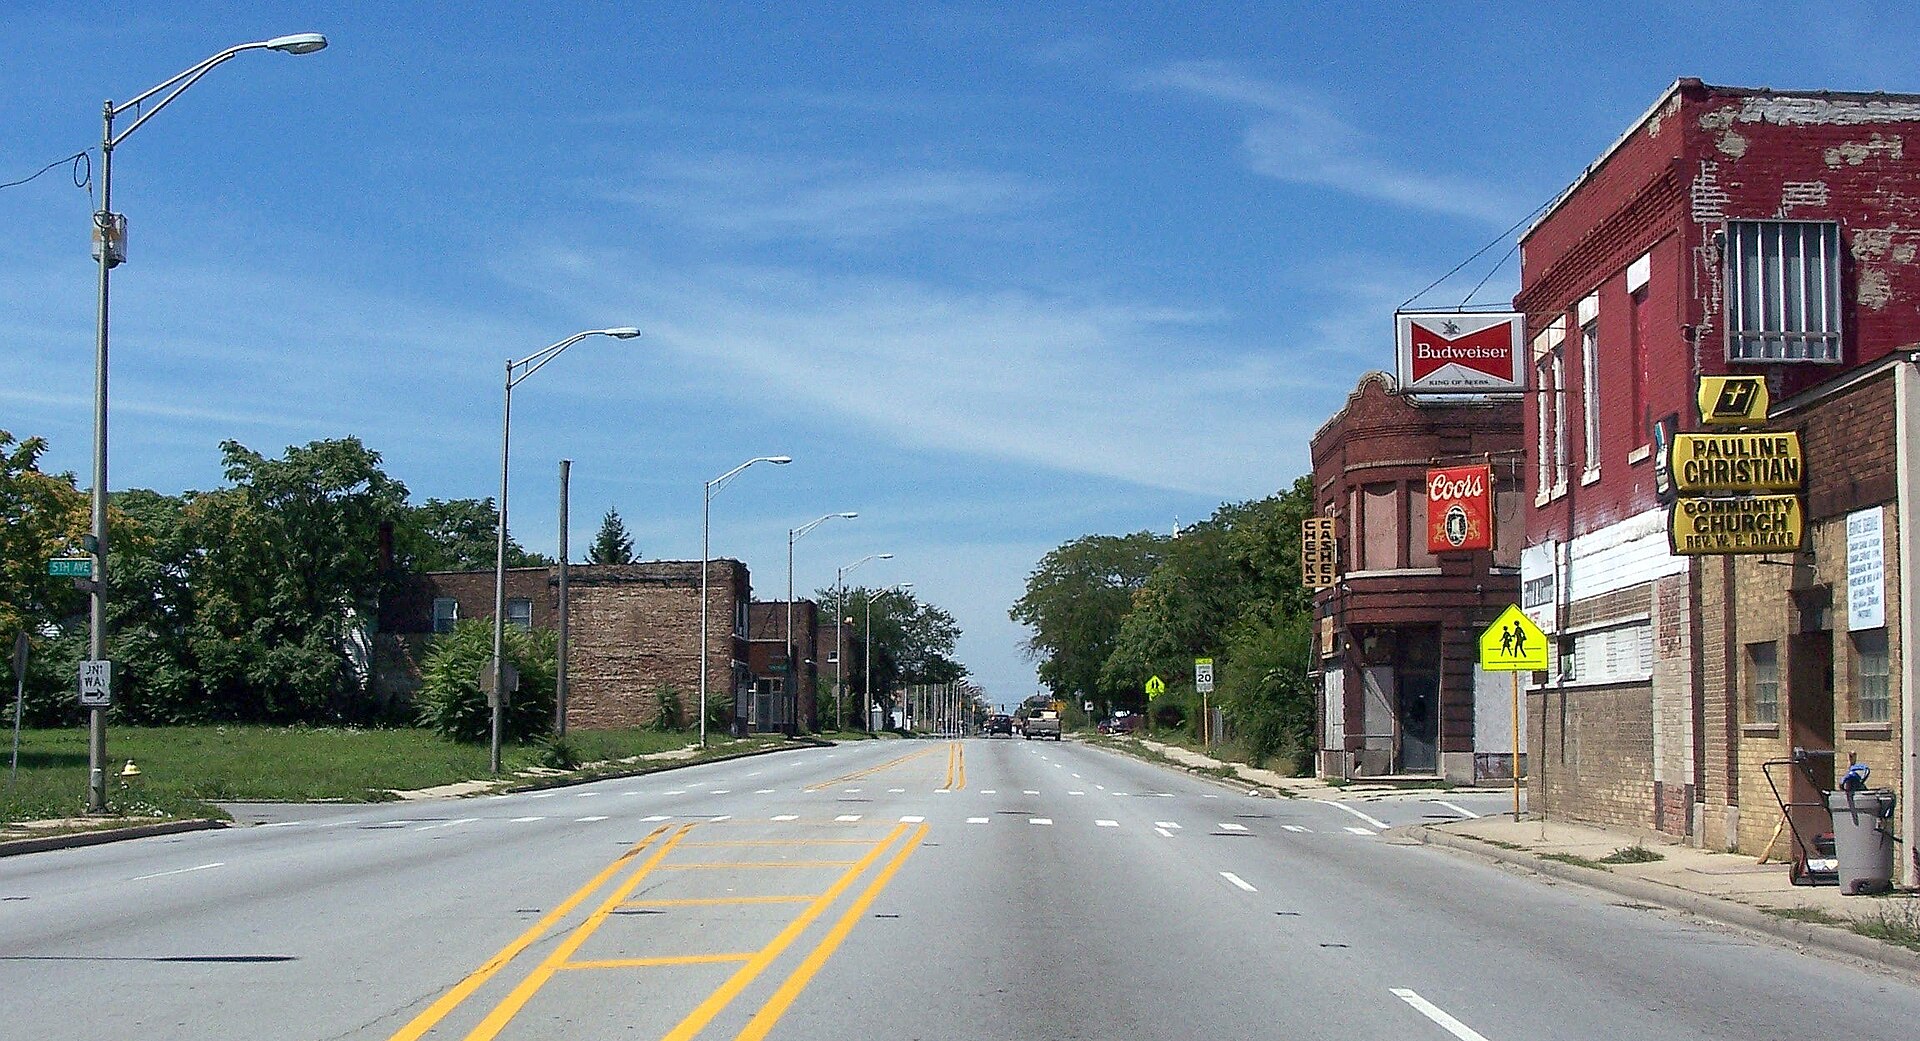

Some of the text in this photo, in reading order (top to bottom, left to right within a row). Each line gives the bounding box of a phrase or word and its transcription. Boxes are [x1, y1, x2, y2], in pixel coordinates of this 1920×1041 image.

[1416, 342, 1508, 359] Budweiser
[1692, 437, 1789, 458] PAULINE
[1683, 457, 1799, 485] CHRISTIAN
[1429, 474, 1483, 501] Coors
[1683, 498, 1794, 517] COMMUNITY
[1692, 512, 1789, 534] CHURCH
[1685, 534, 1712, 549] REV.
[1734, 532, 1746, 547] E.
[1750, 531, 1794, 547] DRAKE
[1304, 520, 1317, 584] CHECKS
[1320, 520, 1332, 584] CASHED
[52, 561, 90, 573] 5TH AVE
[1198, 674, 1211, 682] 20
